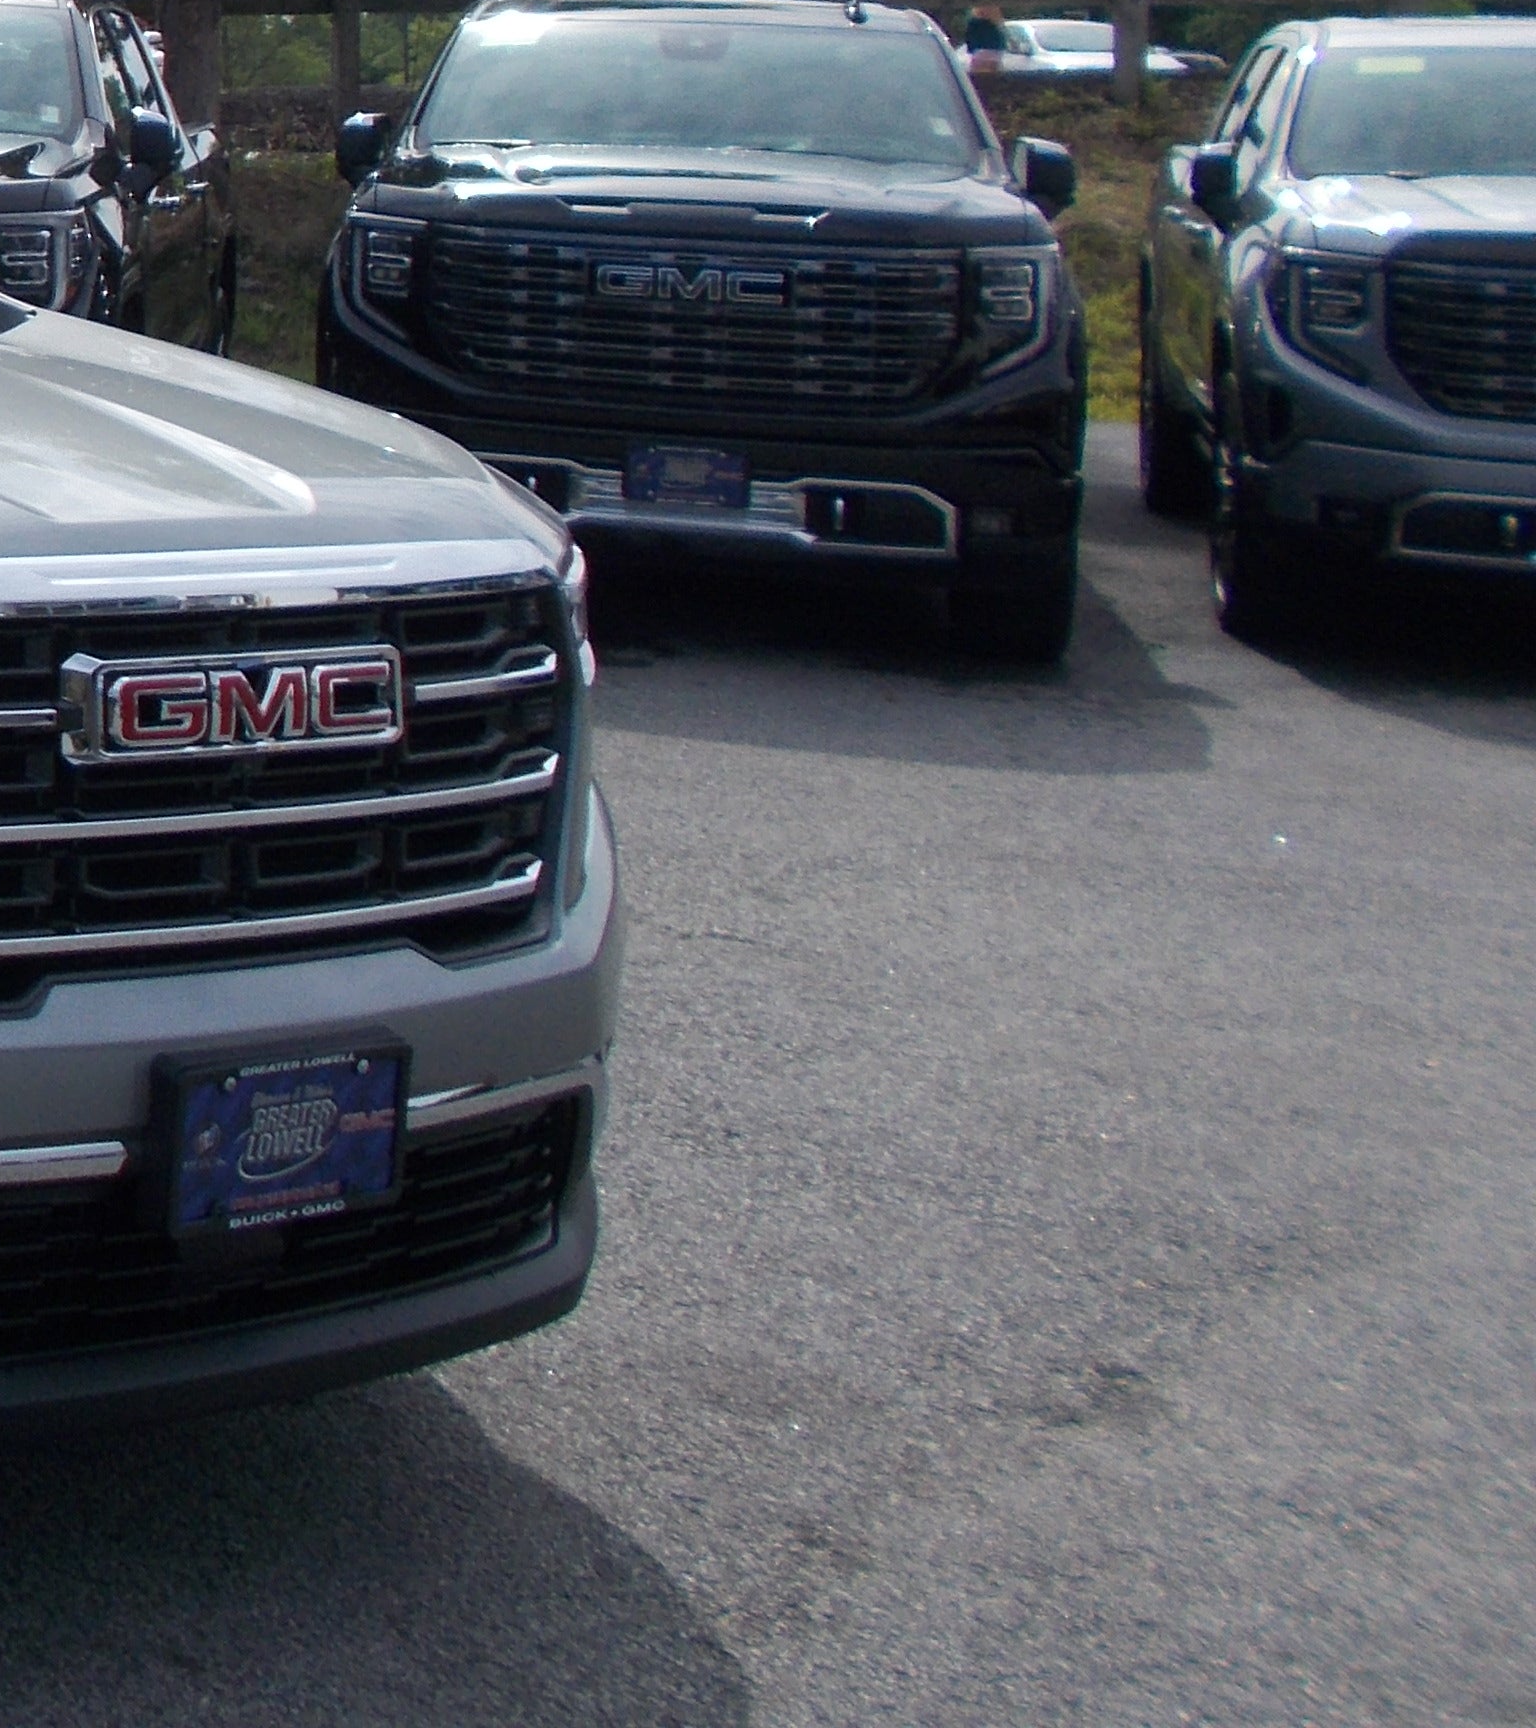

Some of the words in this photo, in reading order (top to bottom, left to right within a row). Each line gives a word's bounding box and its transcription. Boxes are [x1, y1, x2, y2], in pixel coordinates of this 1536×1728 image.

[596, 263, 785, 306] GMC
[108, 660, 393, 748] GMC
[239, 1060, 301, 1077] GREATER
[303, 1051, 356, 1068] LOWELL
[252, 1099, 335, 1133] GREATER
[246, 1125, 325, 1161] LOWELL
[229, 1208, 288, 1230] BUICK
